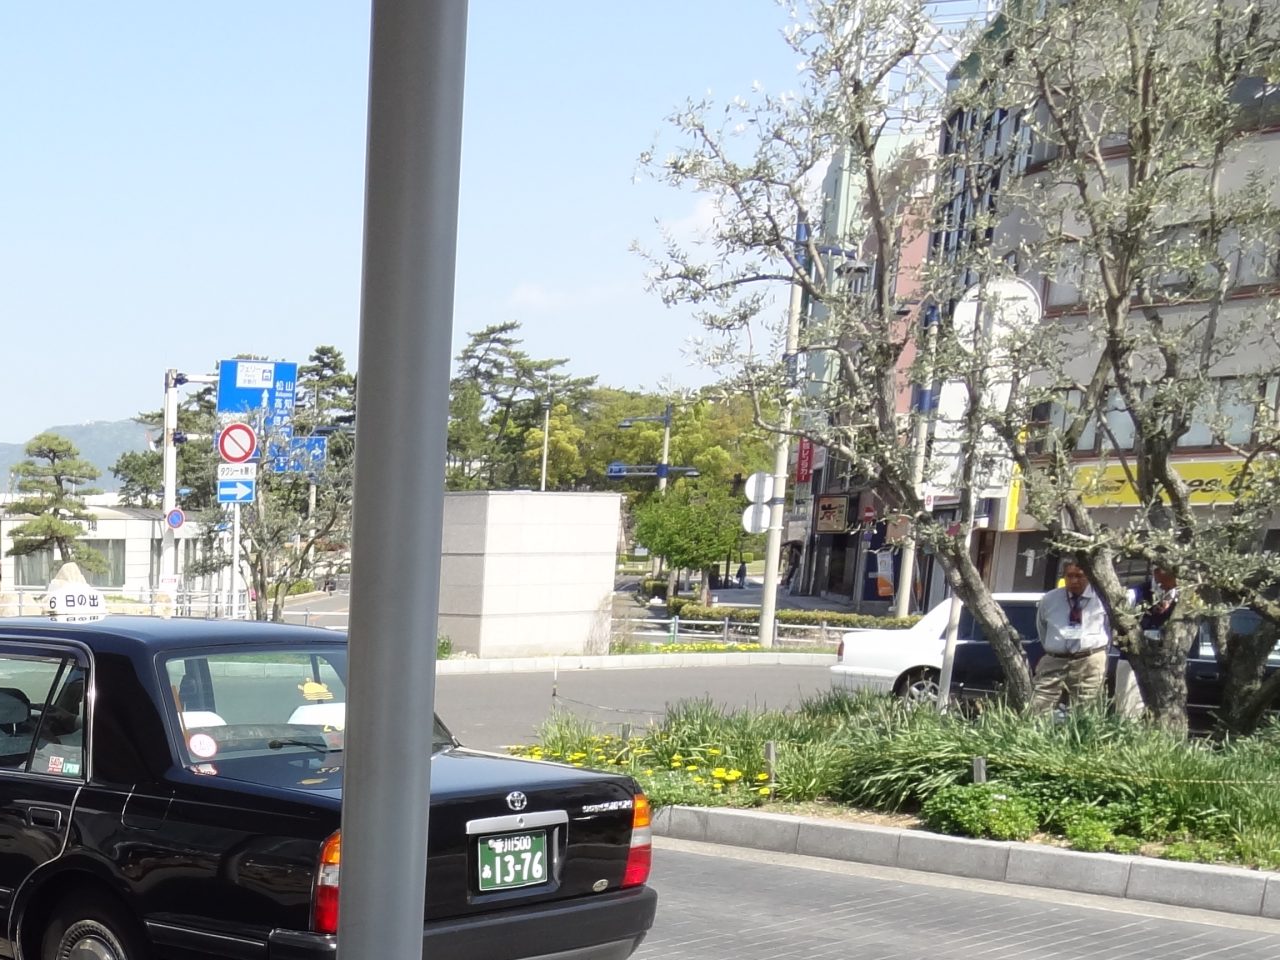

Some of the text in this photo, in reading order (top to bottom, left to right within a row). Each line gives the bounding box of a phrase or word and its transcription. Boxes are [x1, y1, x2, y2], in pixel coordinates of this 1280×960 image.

[49, 594, 99, 609] 6 日の出
[495, 851, 543, 884] 13-76
